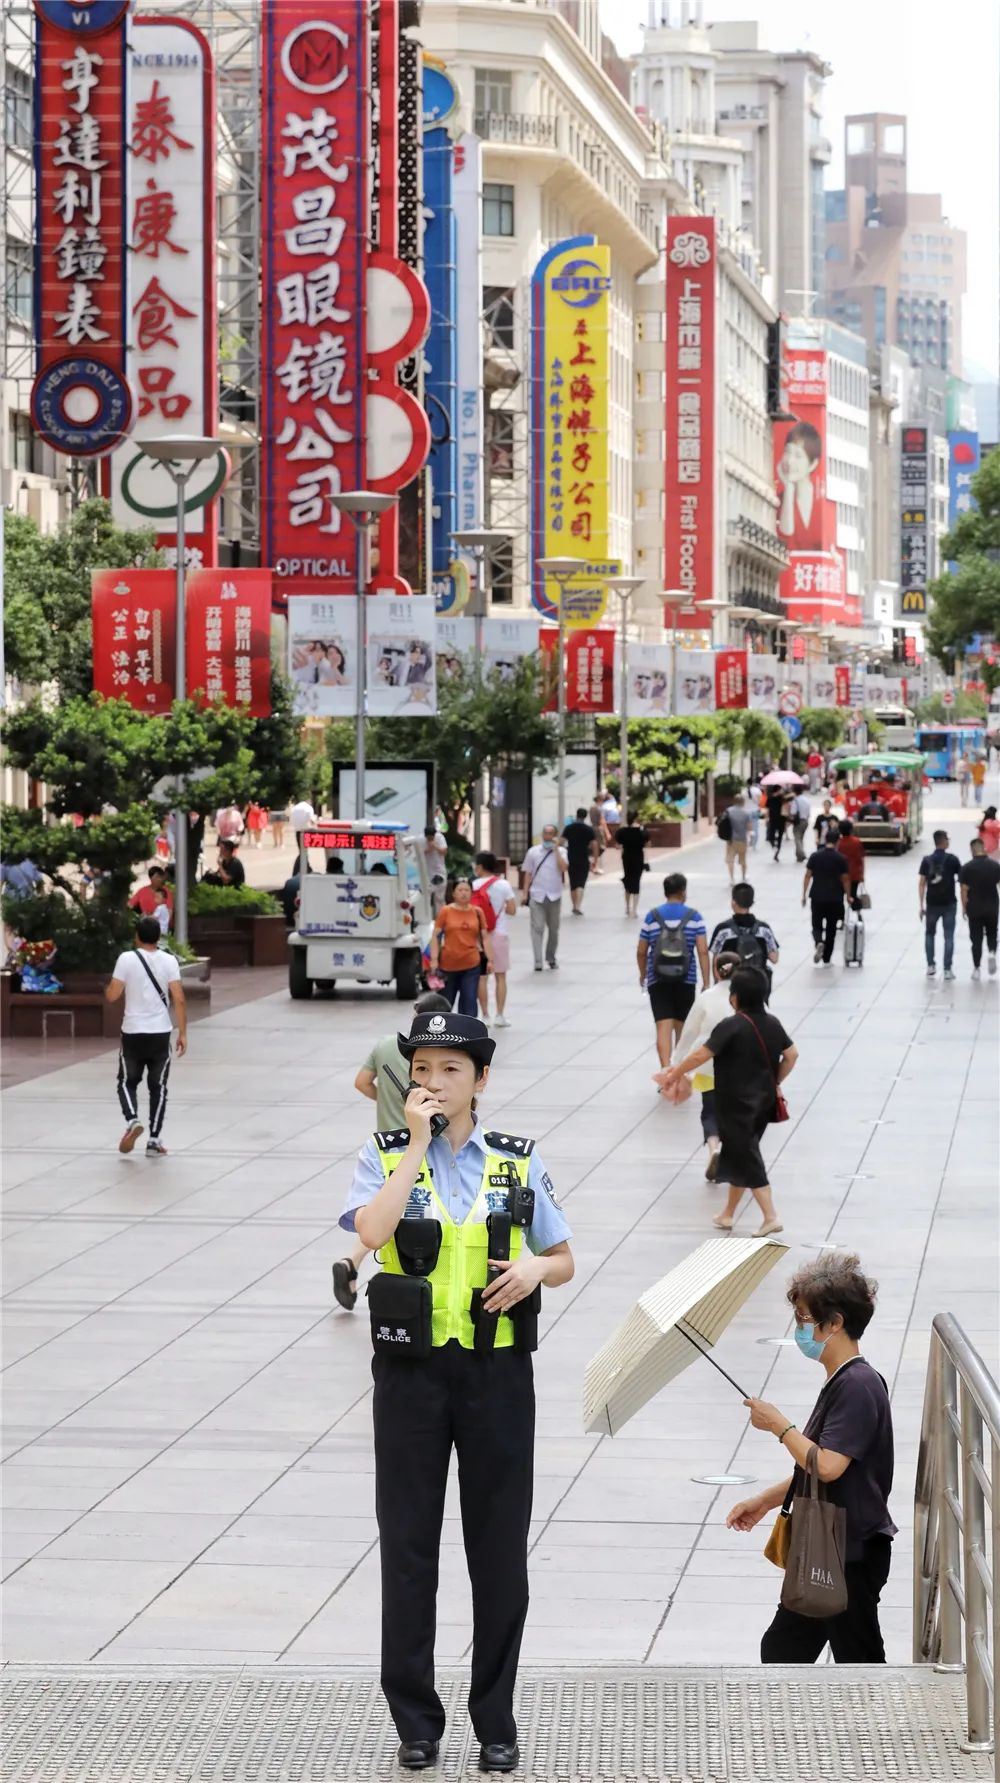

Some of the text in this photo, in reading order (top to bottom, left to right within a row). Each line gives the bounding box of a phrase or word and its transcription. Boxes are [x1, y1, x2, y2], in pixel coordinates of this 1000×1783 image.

[131, 79, 197, 419] 泰康食品
[275, 107, 354, 535] 茂昌眼镜公司
[85, 362, 120, 392] DALI
[677, 278, 701, 483] 上海市第一食品商店
[680, 495, 698, 530] First
[276, 558, 351, 578] OPTICAL
[134, 607, 151, 641] 自由
[111, 607, 130, 686] 公正 法治
[134, 649, 152, 687] 平等
[376, 1333, 411, 1343] POLICE
